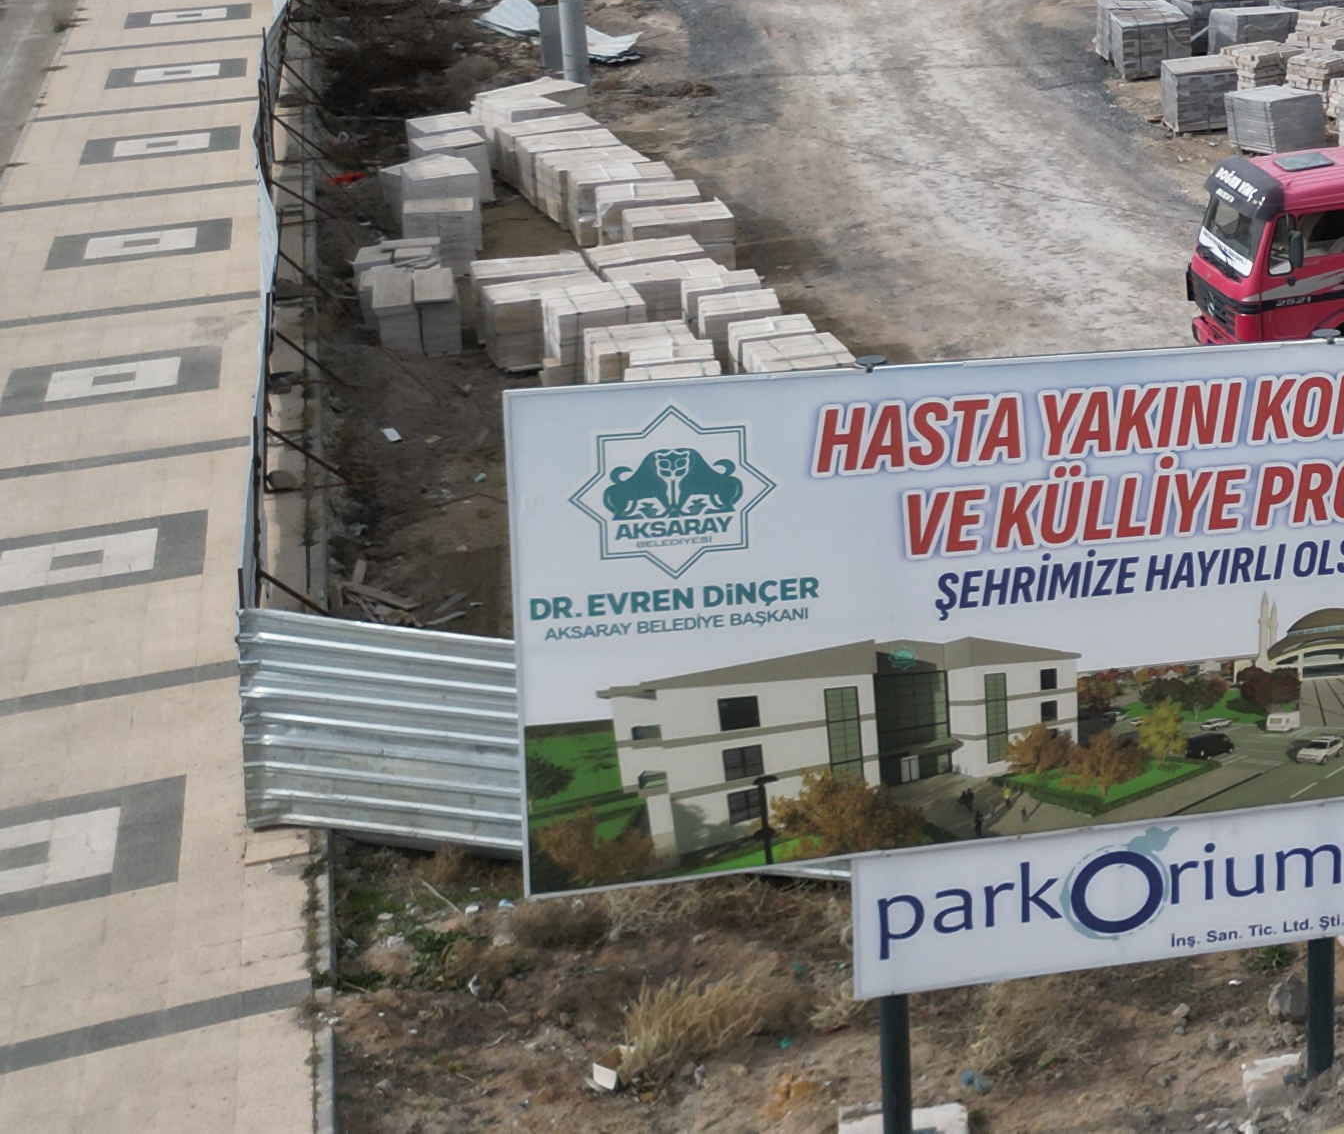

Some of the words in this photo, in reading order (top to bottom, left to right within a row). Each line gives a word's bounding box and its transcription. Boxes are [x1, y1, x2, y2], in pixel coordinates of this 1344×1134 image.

[815, 396, 1022, 474] HASTA
[1042, 381, 1243, 456] YAKINI
[906, 488, 986, 556] VE
[995, 456, 1248, 549] KÜLLİYE
[614, 515, 734, 541] AKSARAY
[934, 548, 1140, 622] ŞEHRİMİZE
[1145, 543, 1288, 592] HAYIRLI
[529, 596, 583, 622] DR.
[587, 586, 695, 618] EVREN
[543, 621, 633, 641] AKSARAY
[636, 612, 725, 636] BELEDİYE
[729, 607, 810, 628] BAŞKANI
[1170, 930, 1201, 950] İnş.
[1206, 928, 1243, 944] San.
[1248, 923, 1278, 938] Tic.
[1282, 918, 1315, 934] Ltd.
